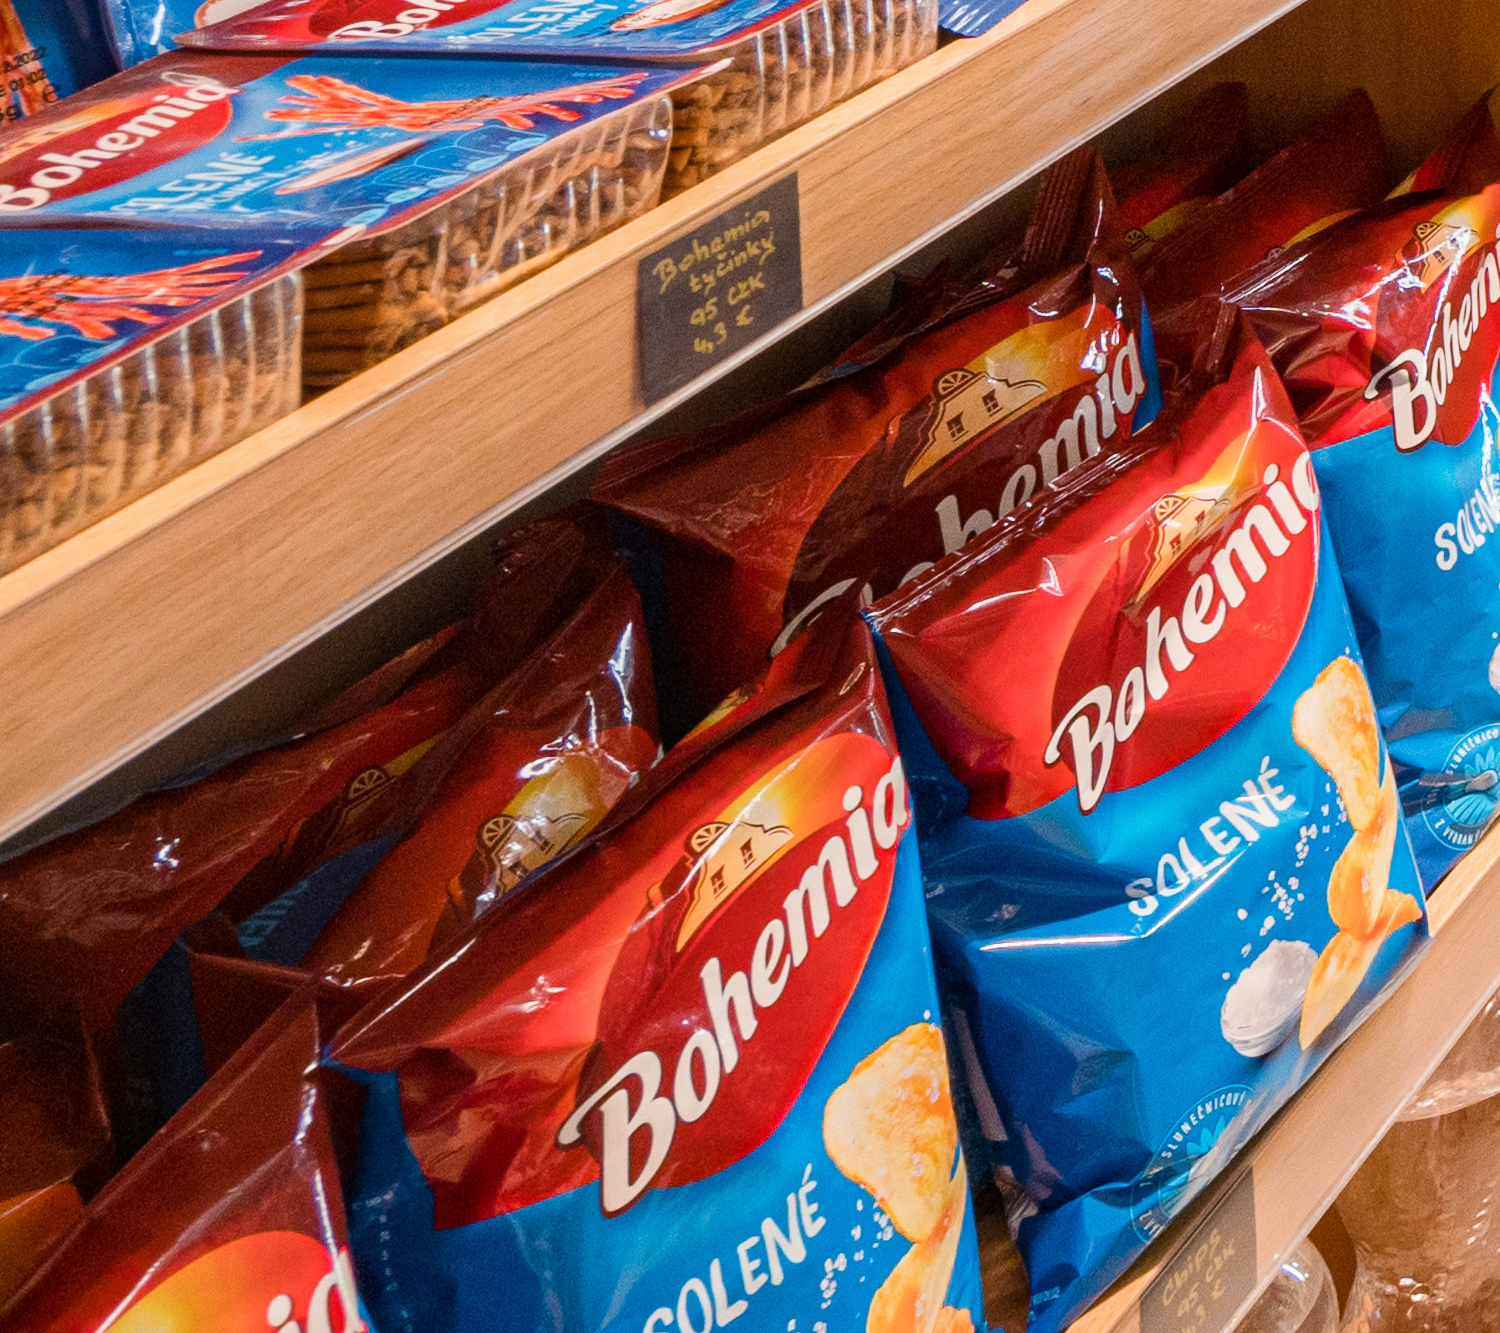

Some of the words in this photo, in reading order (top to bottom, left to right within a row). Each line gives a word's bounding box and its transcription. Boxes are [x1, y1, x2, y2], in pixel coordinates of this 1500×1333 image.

[0, 66, 238, 214] Bohemia
[652, 210, 771, 295] Bohemia
[690, 297, 718, 326] 95
[727, 271, 765, 306] CZK
[1043, 449, 1321, 815] Bohemia
[1126, 756, 1298, 923] SOLENÉ
[558, 754, 912, 1218] Bohemia
